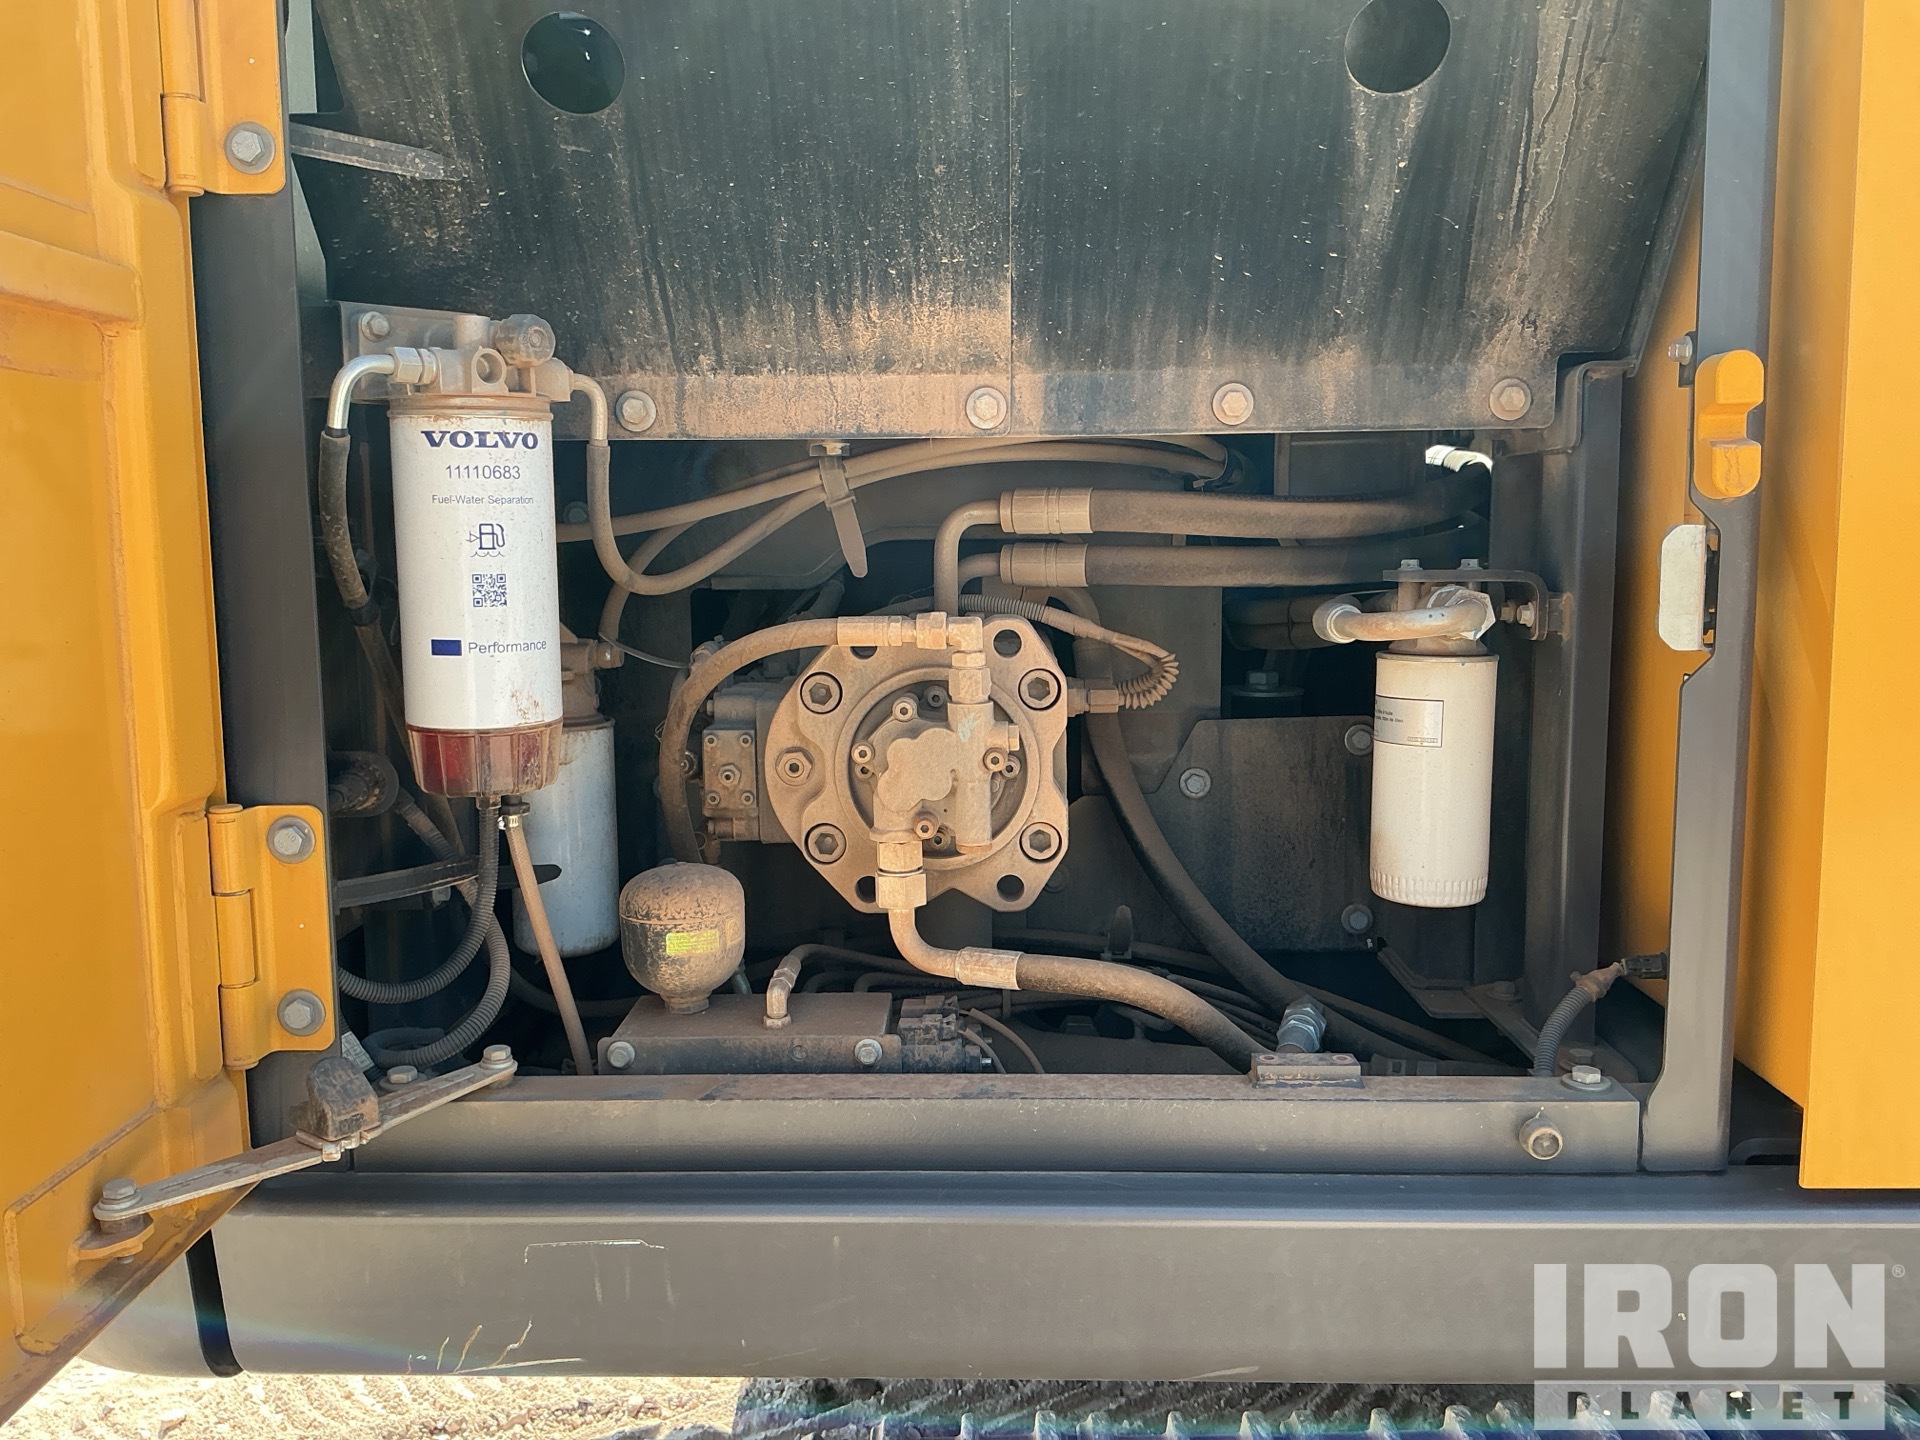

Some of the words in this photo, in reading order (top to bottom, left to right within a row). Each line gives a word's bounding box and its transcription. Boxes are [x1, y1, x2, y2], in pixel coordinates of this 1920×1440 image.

[421, 430, 539, 450] VOLVO
[445, 465, 521, 480] 11110683
[431, 494, 485, 505] Fuel-Water
[487, 495, 534, 506] Separation
[468, 639, 547, 655] Performance
